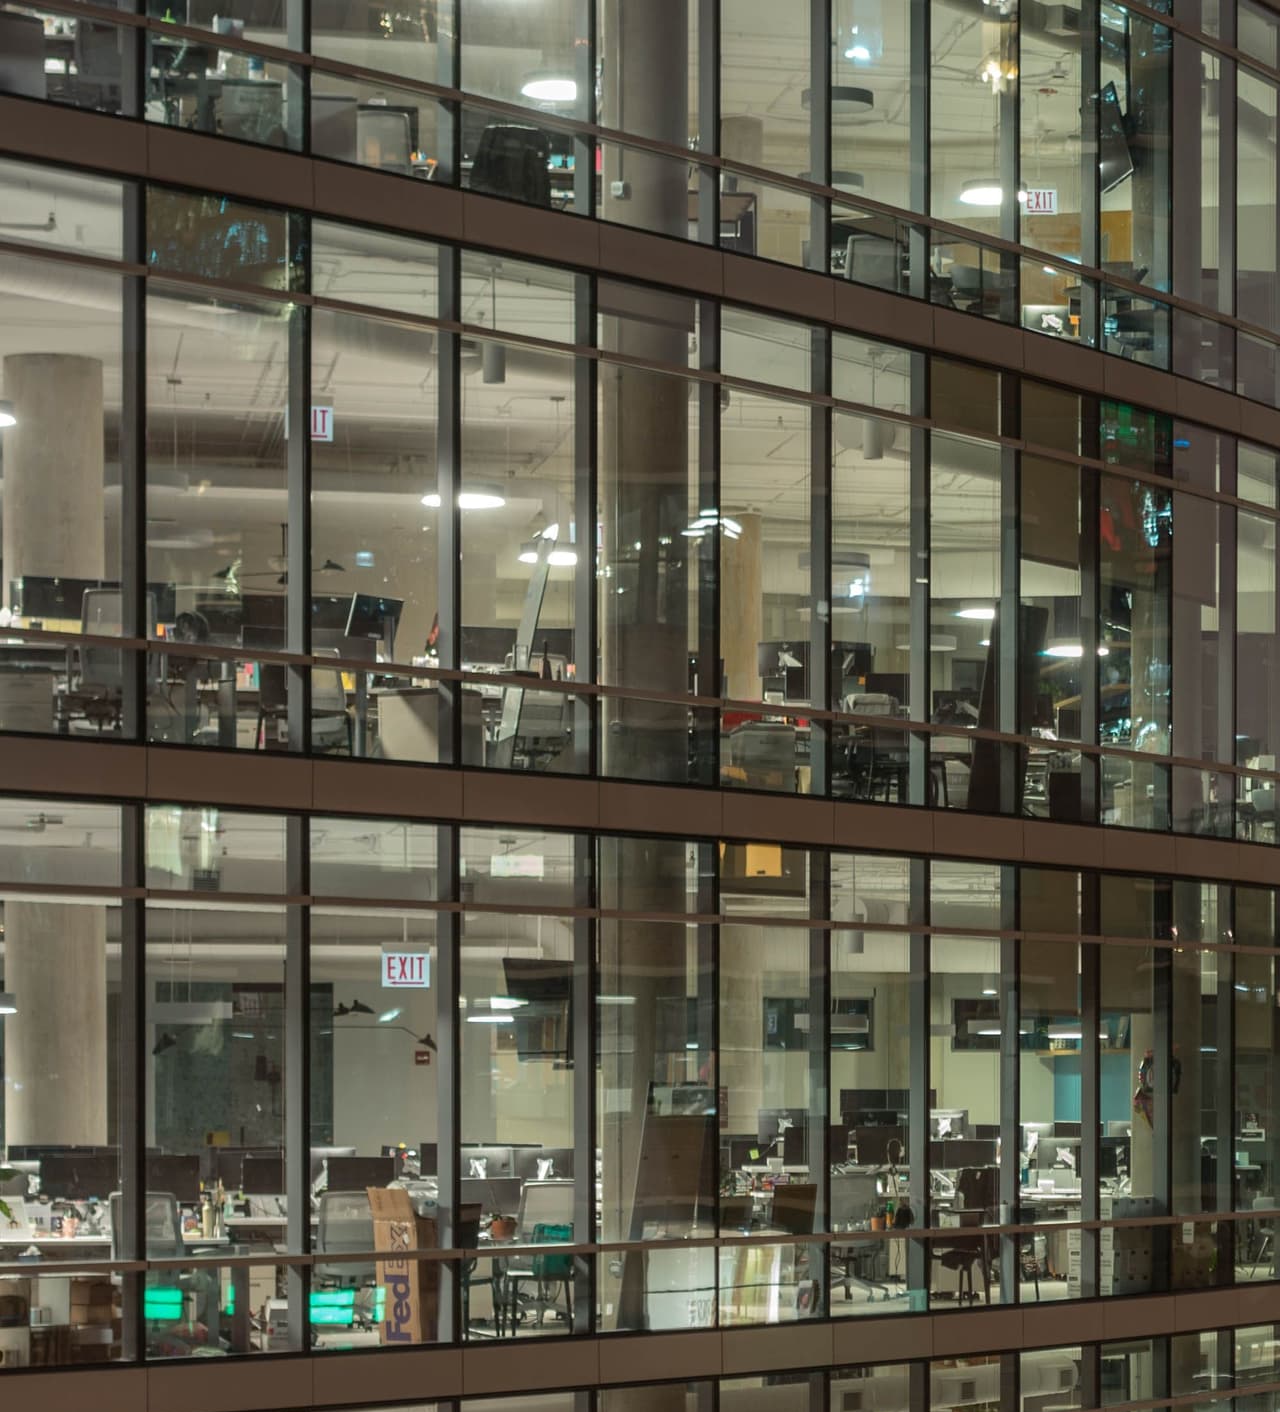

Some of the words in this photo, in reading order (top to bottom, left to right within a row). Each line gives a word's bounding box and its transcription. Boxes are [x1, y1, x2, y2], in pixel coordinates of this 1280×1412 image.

[1026, 191, 1053, 209] EXIT
[313, 409, 328, 433] IT
[387, 956, 424, 979] EXIT
[384, 1224, 411, 1342] FedEx
